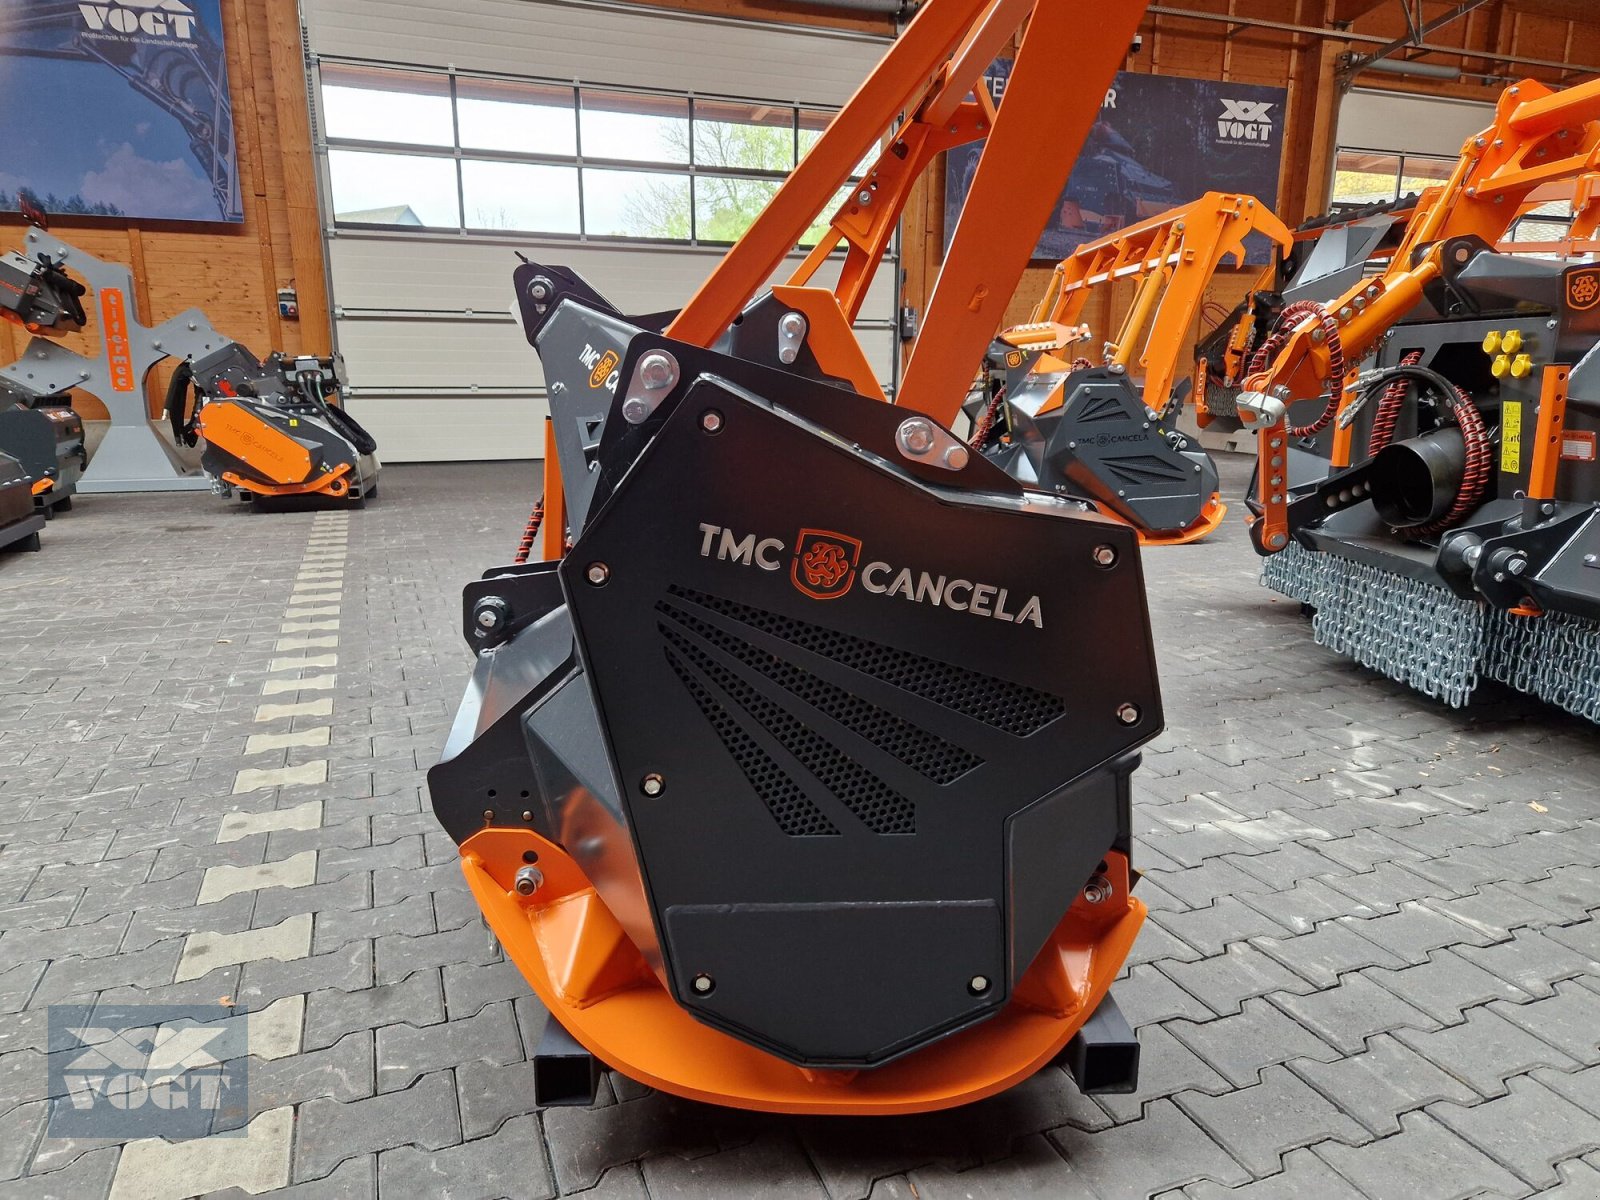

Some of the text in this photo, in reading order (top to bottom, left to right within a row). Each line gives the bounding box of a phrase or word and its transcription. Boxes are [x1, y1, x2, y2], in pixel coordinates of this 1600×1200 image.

[78, 4, 196, 39] VOGT
[1217, 120, 1273, 141] VOGT
[578, 343, 620, 394] TMC CA
[1077, 434, 1150, 445] TMC CANCELA
[699, 522, 1045, 629] TMC CANCELA
